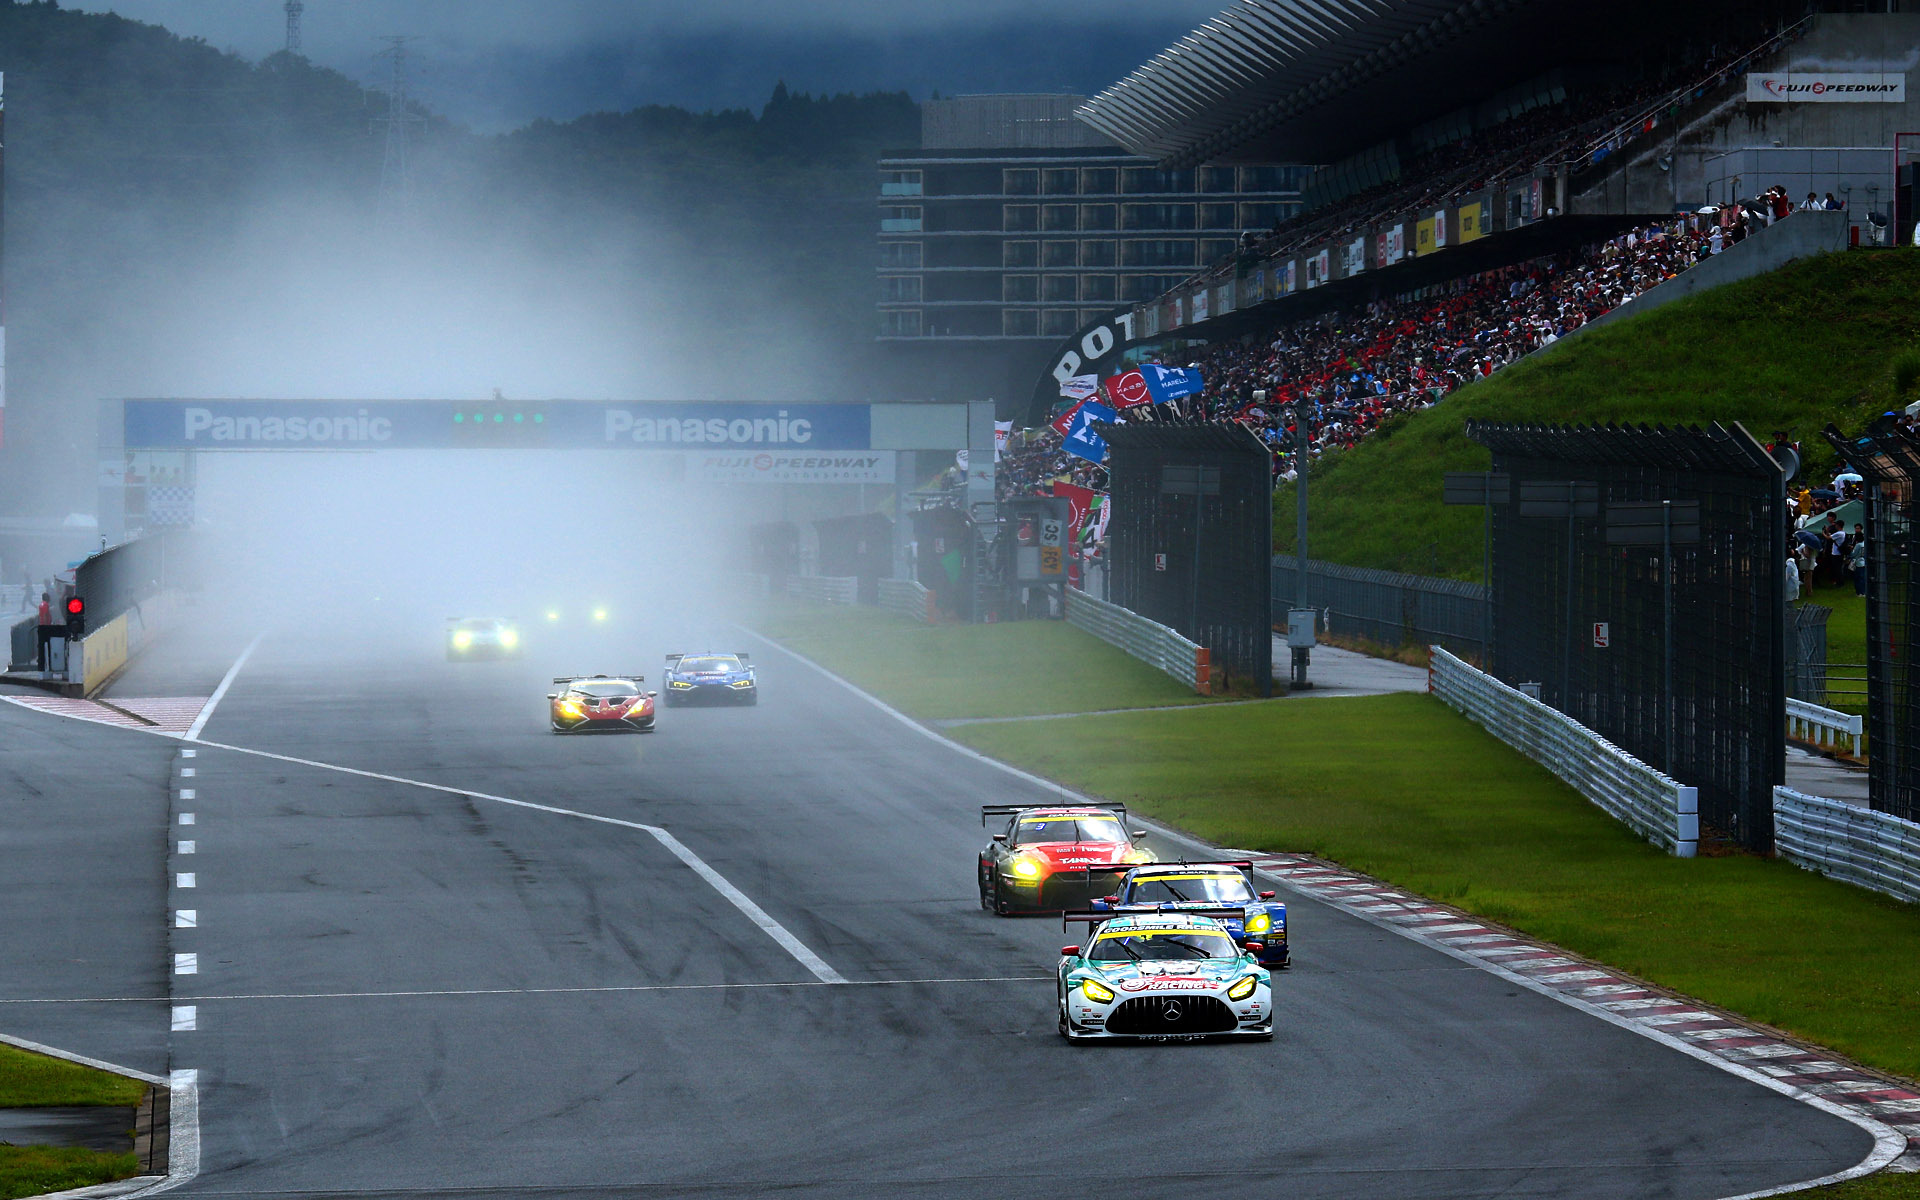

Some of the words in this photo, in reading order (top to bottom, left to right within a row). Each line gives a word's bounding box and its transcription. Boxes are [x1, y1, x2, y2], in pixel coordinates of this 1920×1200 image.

[1778, 84, 1810, 92] FUJI
[1812, 82, 1898, 94] SPEEDWAY
[1161, 377, 1189, 389] MARELLI
[185, 408, 392, 441] Panasonic
[605, 410, 812, 444] Panasonic
[704, 457, 751, 468] FUJI
[753, 454, 881, 471] SPEEDWAY
[1044, 524, 1059, 541] SC
[1044, 551, 1058, 569] FCY
[1059, 857, 1102, 865] TANAX
[1104, 924, 1173, 934] GOODSMILE
[1176, 924, 1221, 932] RACING
[1149, 979, 1204, 991] RACING
